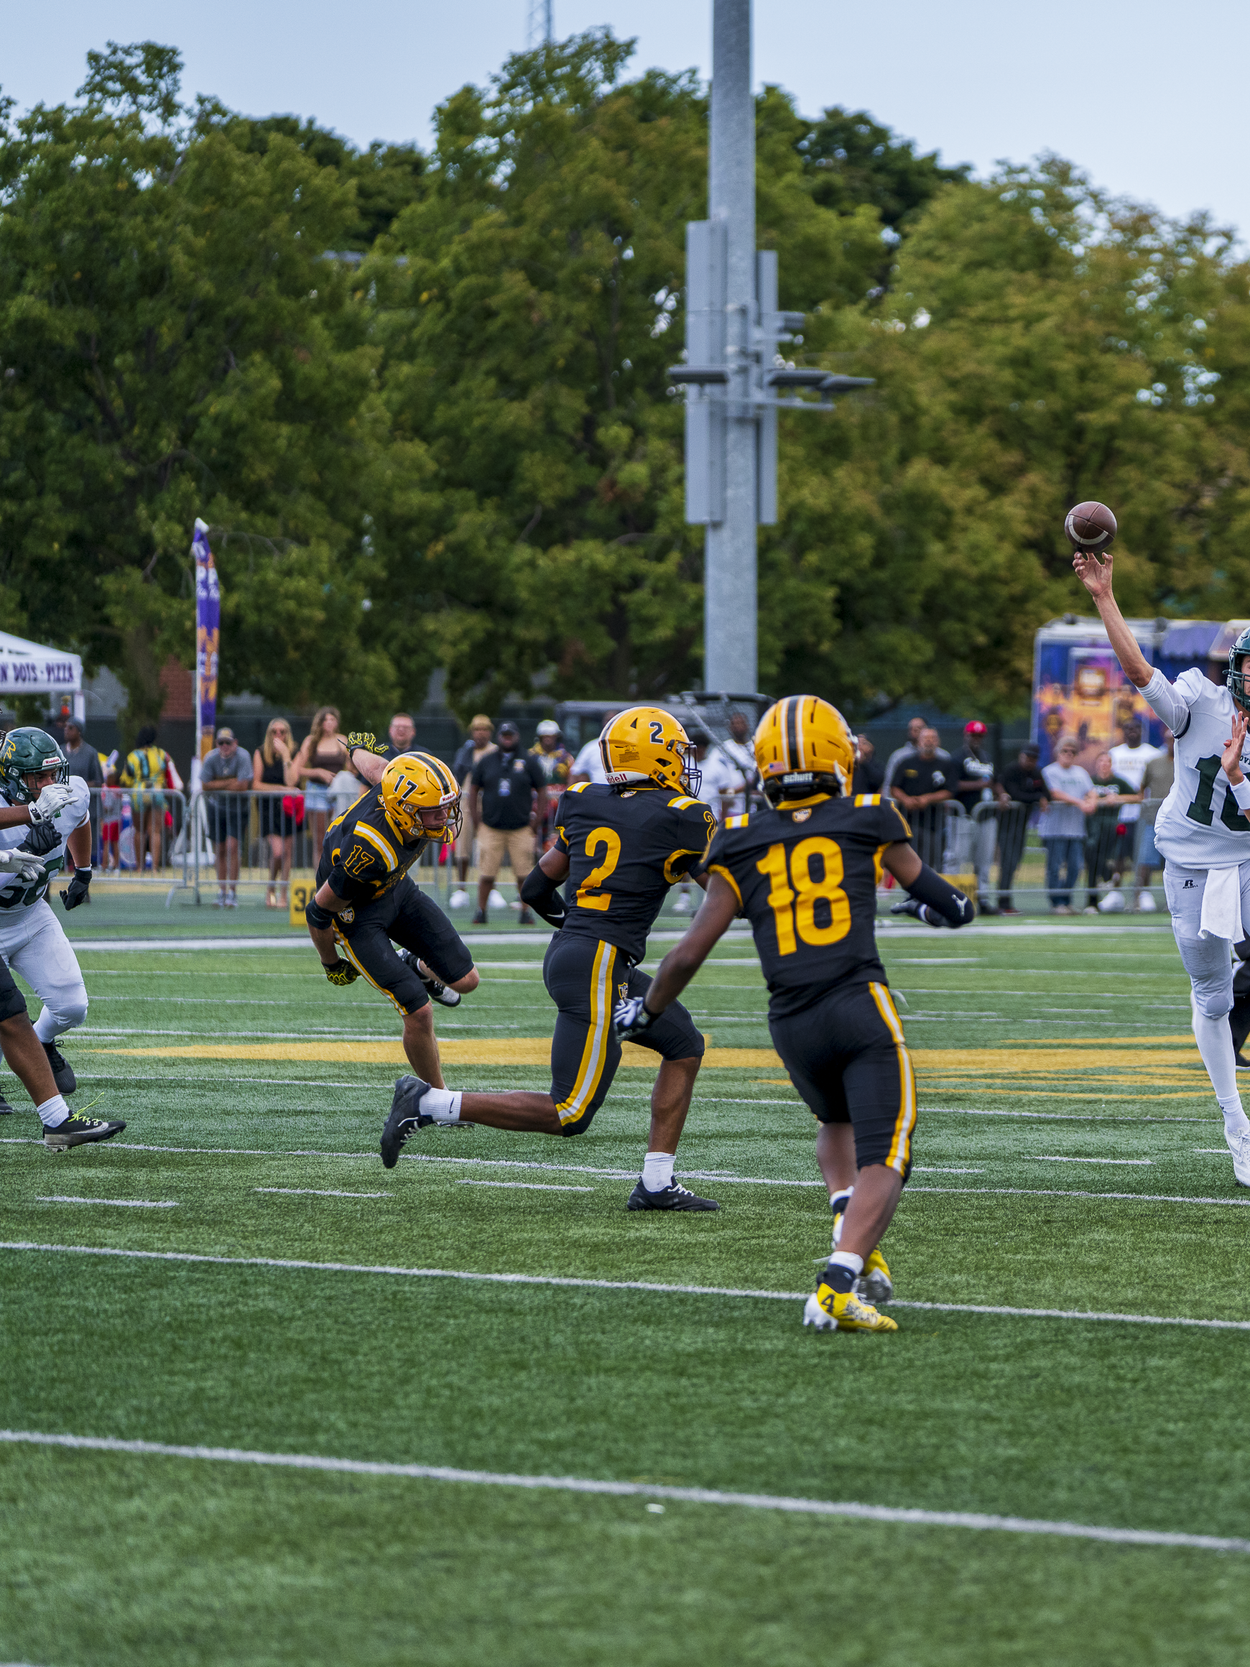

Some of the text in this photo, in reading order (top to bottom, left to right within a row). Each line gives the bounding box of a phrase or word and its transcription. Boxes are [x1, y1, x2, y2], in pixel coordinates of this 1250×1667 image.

[648, 721, 665, 745] 2
[393, 774, 418, 800] 17
[344, 844, 376, 875] 17
[576, 826, 622, 911] 2
[756, 836, 852, 957] 18
[821, 1294, 835, 1314] 4
